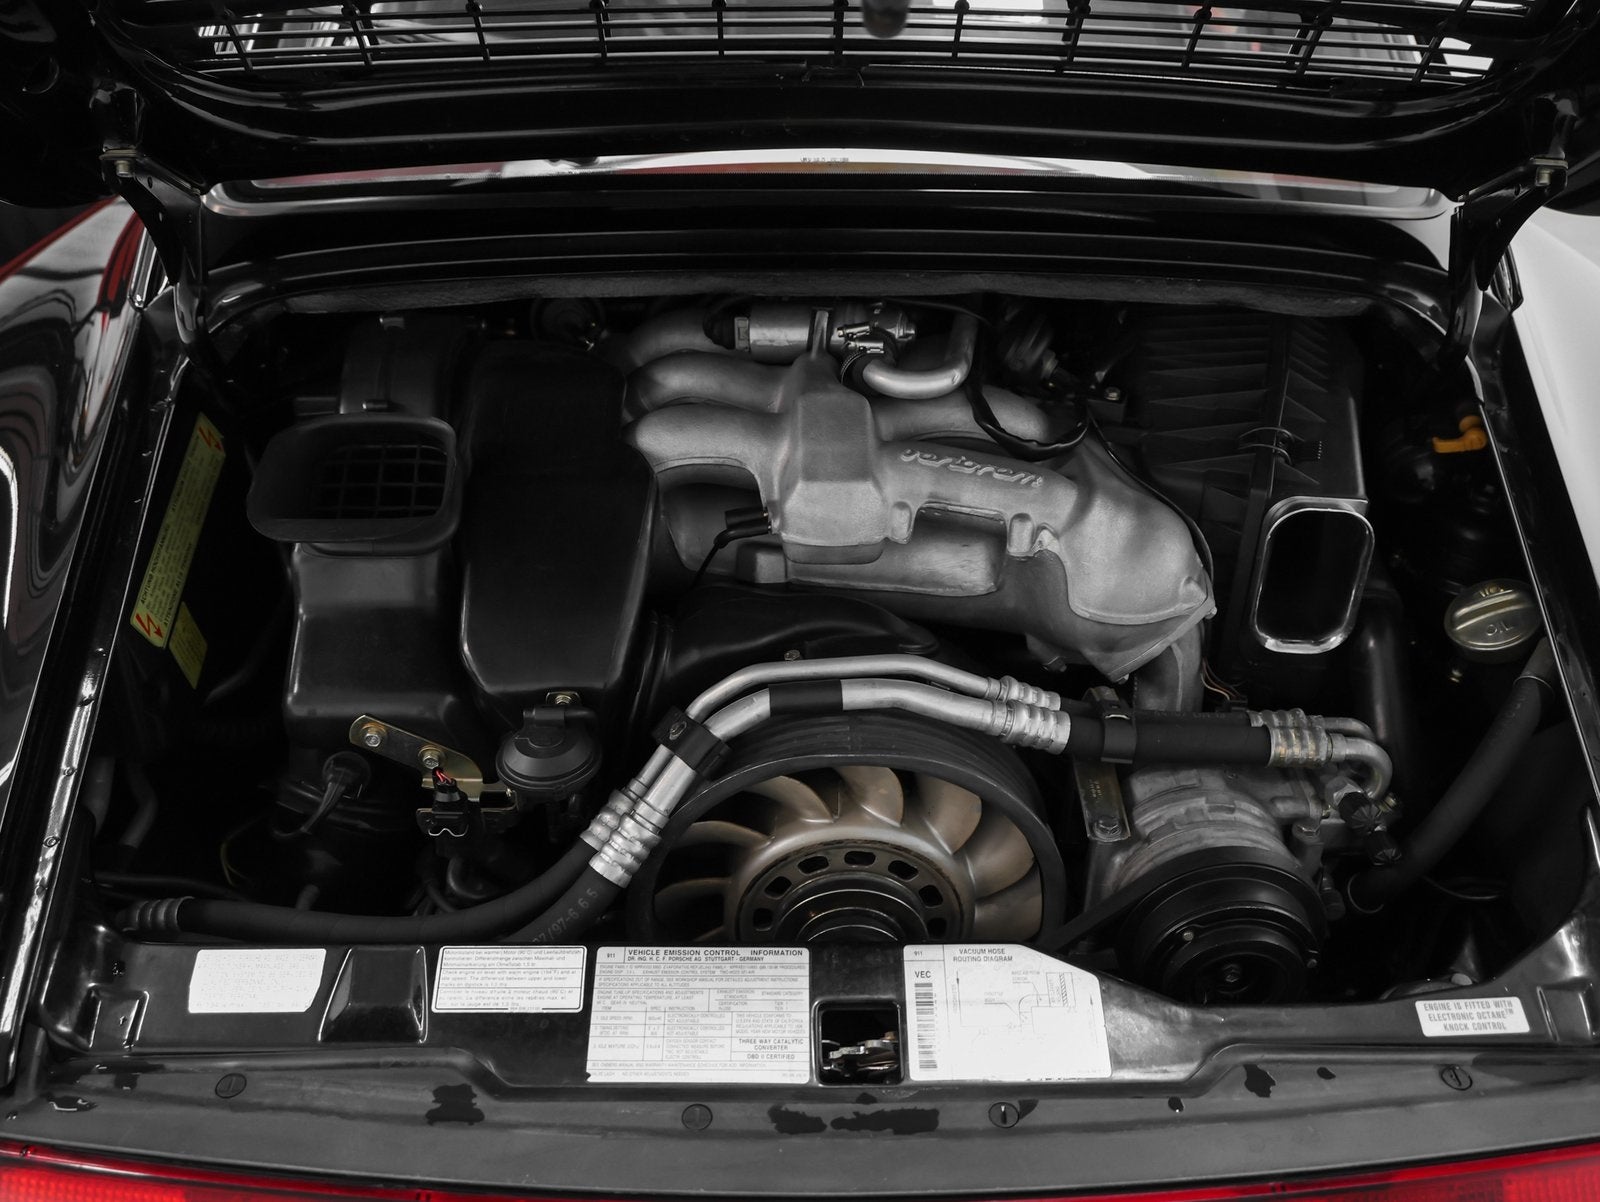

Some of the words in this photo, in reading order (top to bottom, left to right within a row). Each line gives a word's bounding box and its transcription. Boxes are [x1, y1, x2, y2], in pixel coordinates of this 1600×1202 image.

[1486, 620, 1515, 637] OIL
[1423, 1002, 1452, 1011] ENGINE
[1454, 1001, 1462, 1010] IS
[1464, 1000, 1491, 1009] FITTED
[1493, 1000, 1513, 1008] WITH
[1428, 1012, 1475, 1022] ELECTRONIC
[1443, 1023, 1470, 1032] KNOCK
[1472, 1022, 1507, 1031] CONTROL
